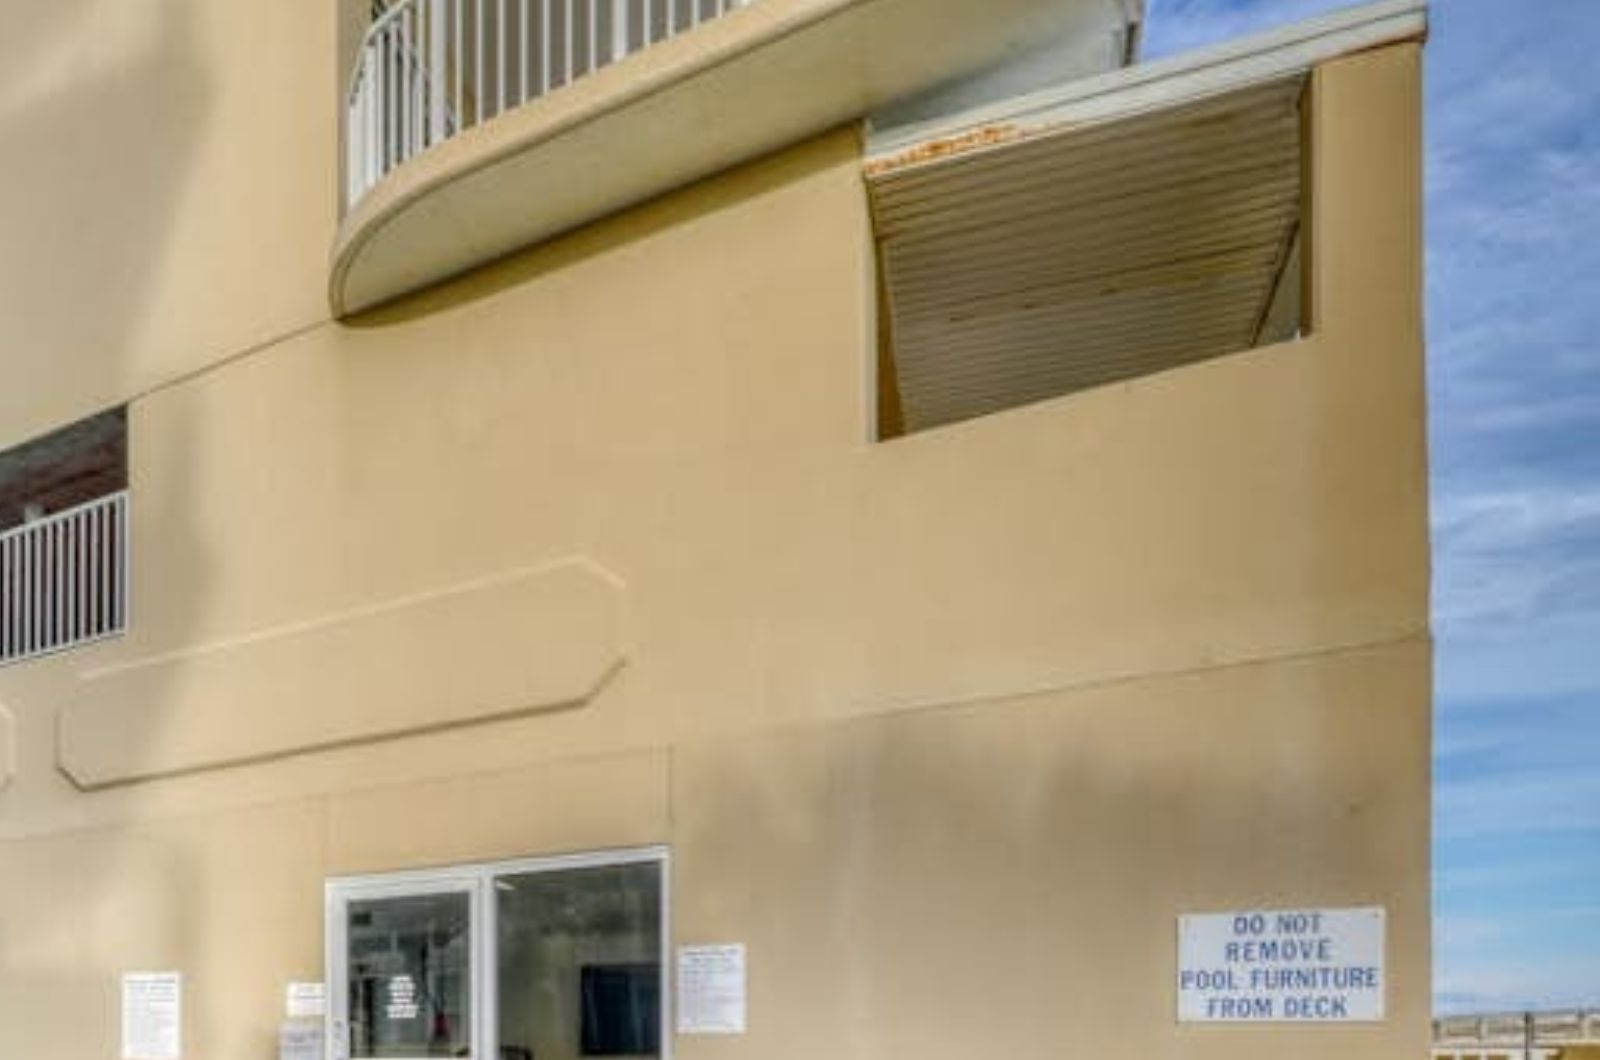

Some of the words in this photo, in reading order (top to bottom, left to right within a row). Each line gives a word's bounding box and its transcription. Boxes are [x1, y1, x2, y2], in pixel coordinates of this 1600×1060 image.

[1233, 915, 1264, 935] DO
[1277, 914, 1323, 935] NOT
[1225, 939, 1333, 962] REMOVE
[1180, 968, 1238, 990] POOL
[1251, 967, 1379, 989] FURNITURE
[1206, 998, 1273, 1018] FROM
[1284, 997, 1348, 1018] DECK
